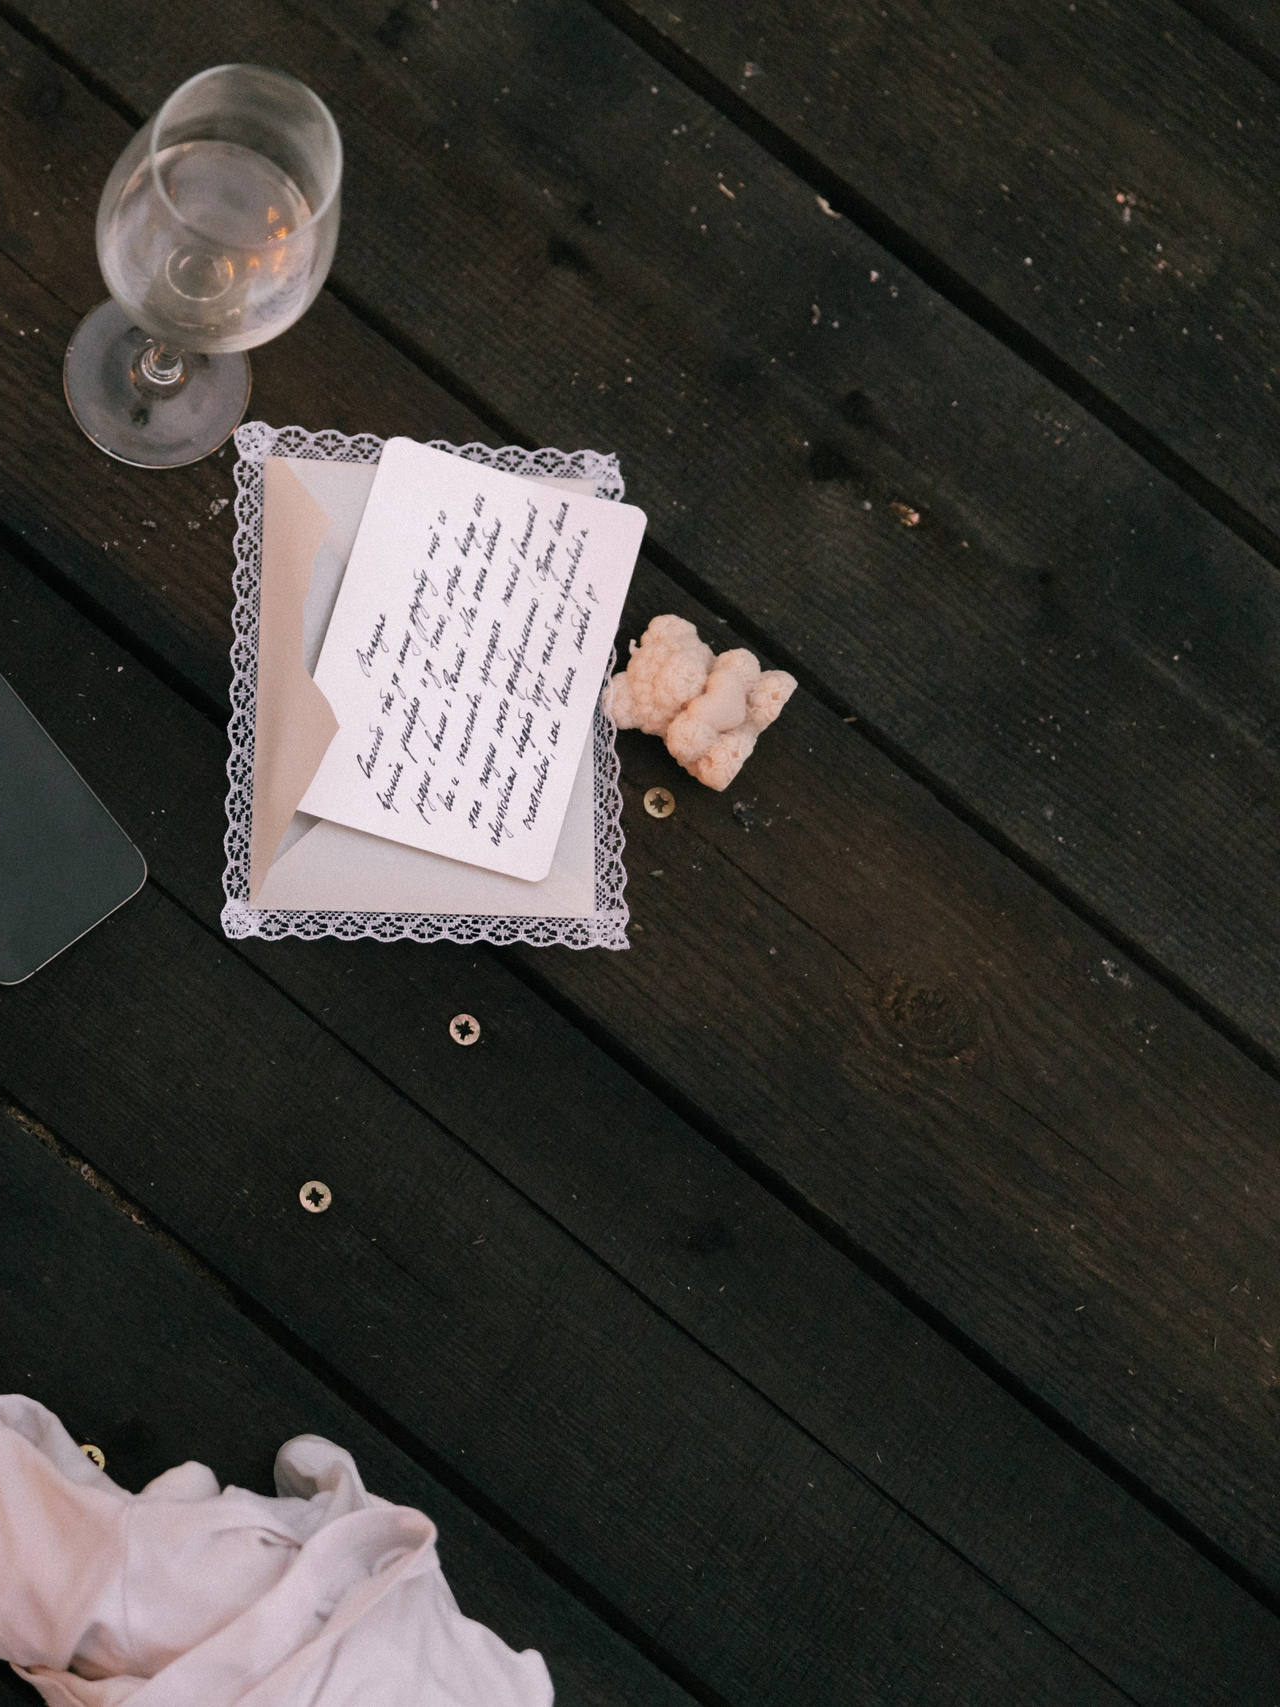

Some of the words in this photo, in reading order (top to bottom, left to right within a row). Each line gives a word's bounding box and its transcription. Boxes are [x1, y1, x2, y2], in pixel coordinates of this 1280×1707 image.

[436, 509, 447, 526] со
[472, 492, 486, 518] есть
[426, 524, 441, 560] ещё
[453, 520, 482, 558] всегда
[481, 516, 502, 565] любим
[509, 497, 538, 560] важный
[471, 566, 488, 602] очень
[500, 557, 521, 607] такой
[558, 534, 584, 603] красивой
[407, 568, 439, 642] дружбу
[458, 605, 478, 638] Мы
[552, 602, 565, 624] же
[395, 629, 421, 669] нашу
[429, 613, 451, 651] тепло,
[540, 620, 559, 666] такой
[570, 603, 592, 655] любовь
[418, 657, 442, 689] за
[418, 676, 429, 688] и
[467, 798, 482, 829] этап
[477, 741, 501, 790] жизни
[491, 697, 510, 739] почти
[534, 538, 560, 582] Пусть
[548, 500, 570, 537] ваша
[378, 687, 395, 717] тебе
[390, 671, 407, 700] за
[443, 698, 452, 708] с
[524, 670, 552, 712] будет
[551, 665, 577, 707] ваша
[399, 695, 427, 764] универа
[423, 710, 448, 752] вами
[455, 691, 482, 767] счастливы
[510, 707, 536, 759] свадьба
[546, 719, 561, 747] как
[355, 724, 384, 780] Спасибо
[427, 755, 436, 766] с
[375, 761, 404, 814] времён
[409, 769, 437, 825] рядом
[435, 789, 456, 812] вас
[450, 775, 460, 787] и
[487, 765, 518, 847] августовская
